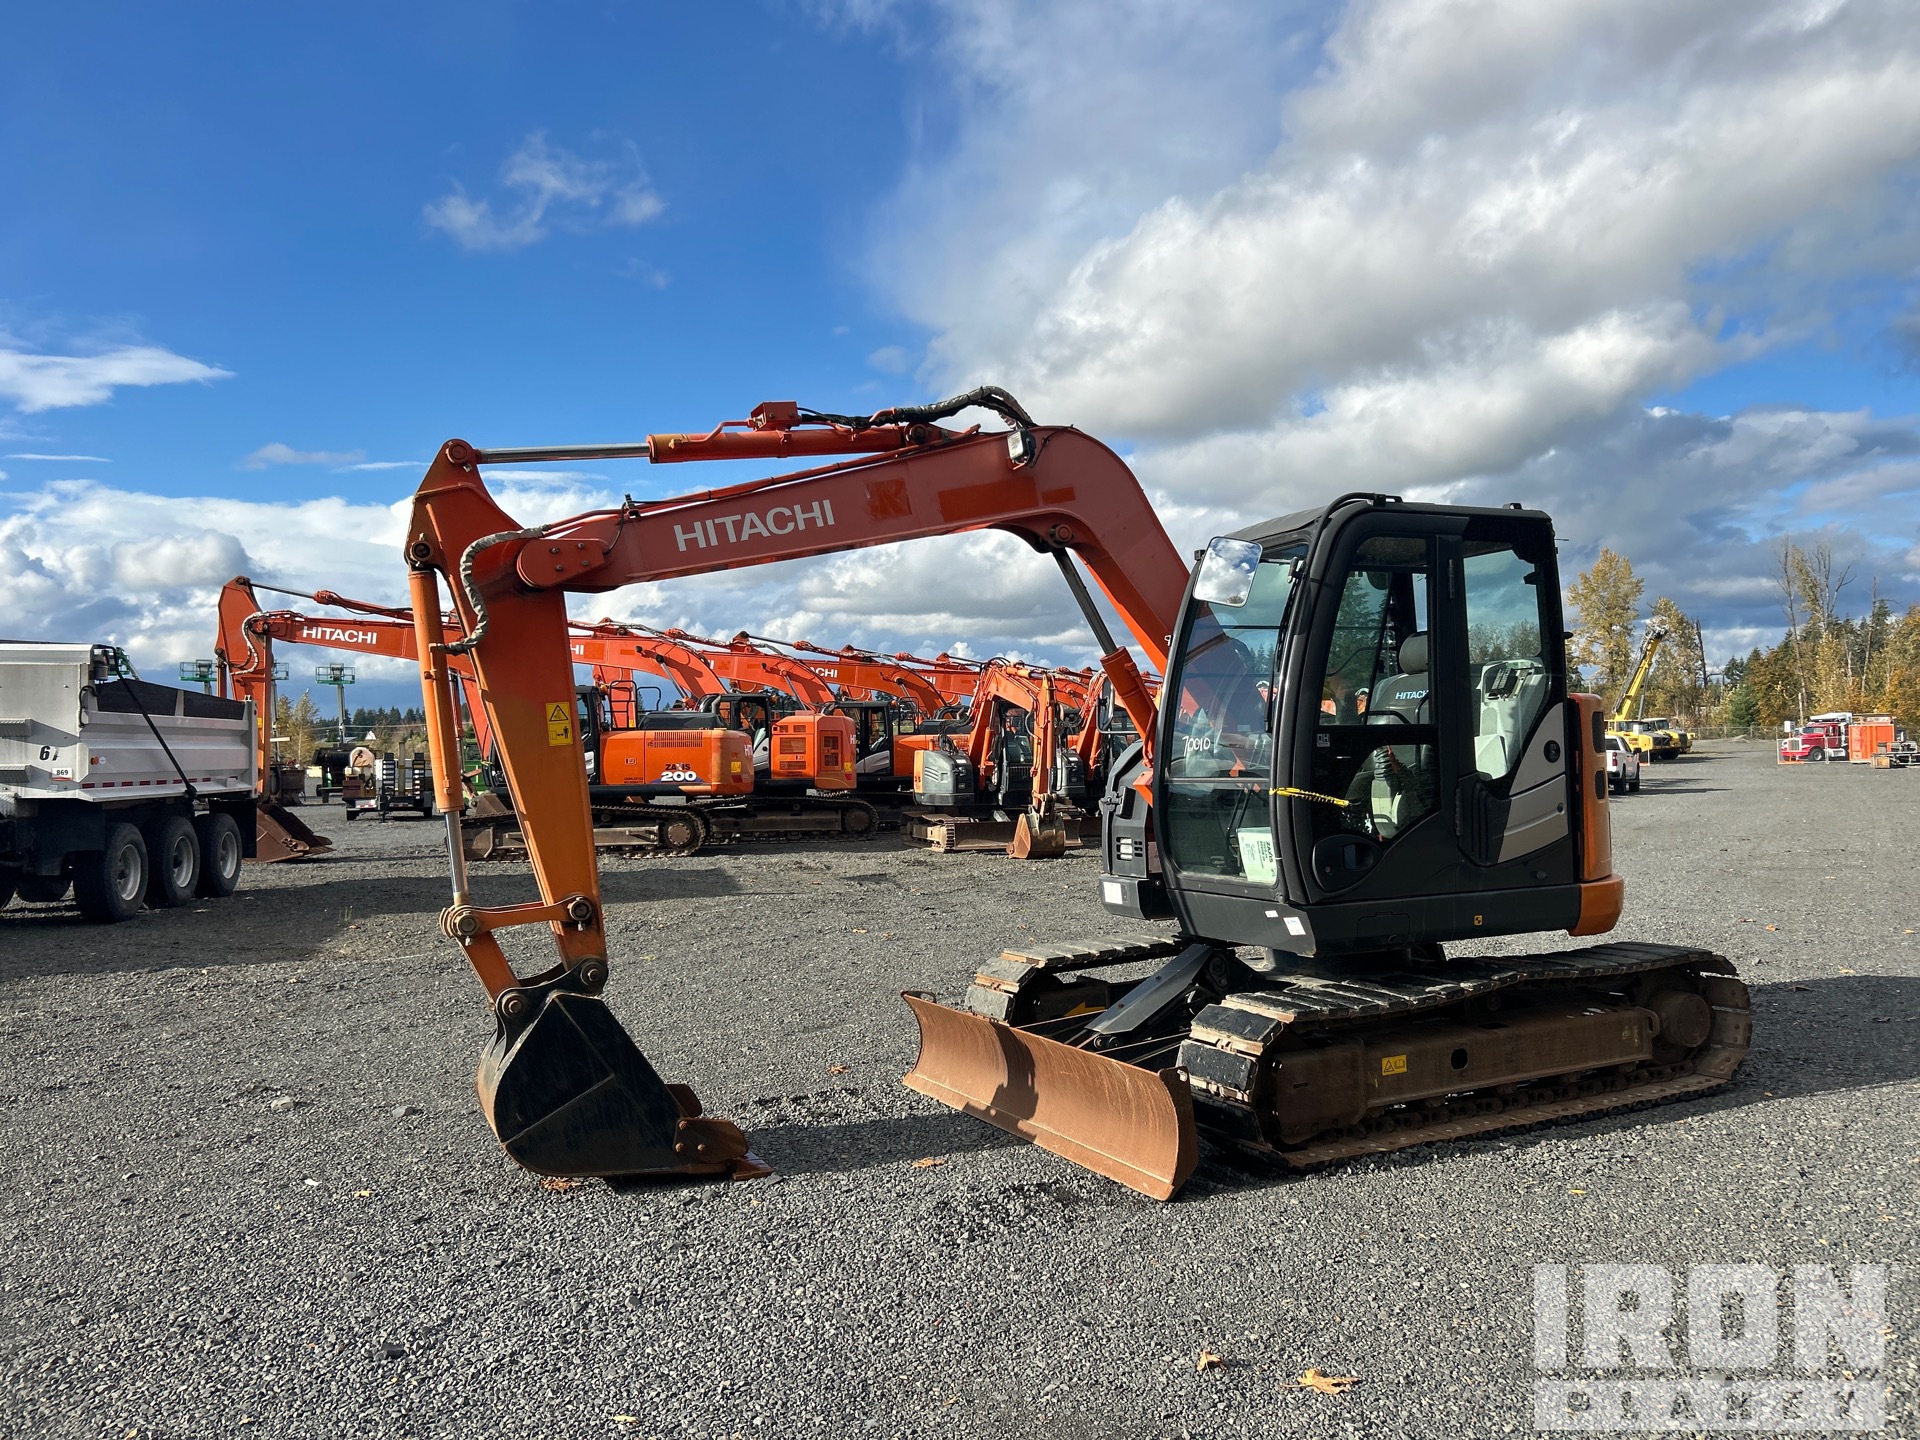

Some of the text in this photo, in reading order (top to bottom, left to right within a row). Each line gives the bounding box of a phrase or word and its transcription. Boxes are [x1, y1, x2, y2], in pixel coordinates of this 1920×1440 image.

[673, 499, 835, 552] HITACHI
[302, 625, 377, 645] HITACHI
[660, 771, 697, 782] 200
